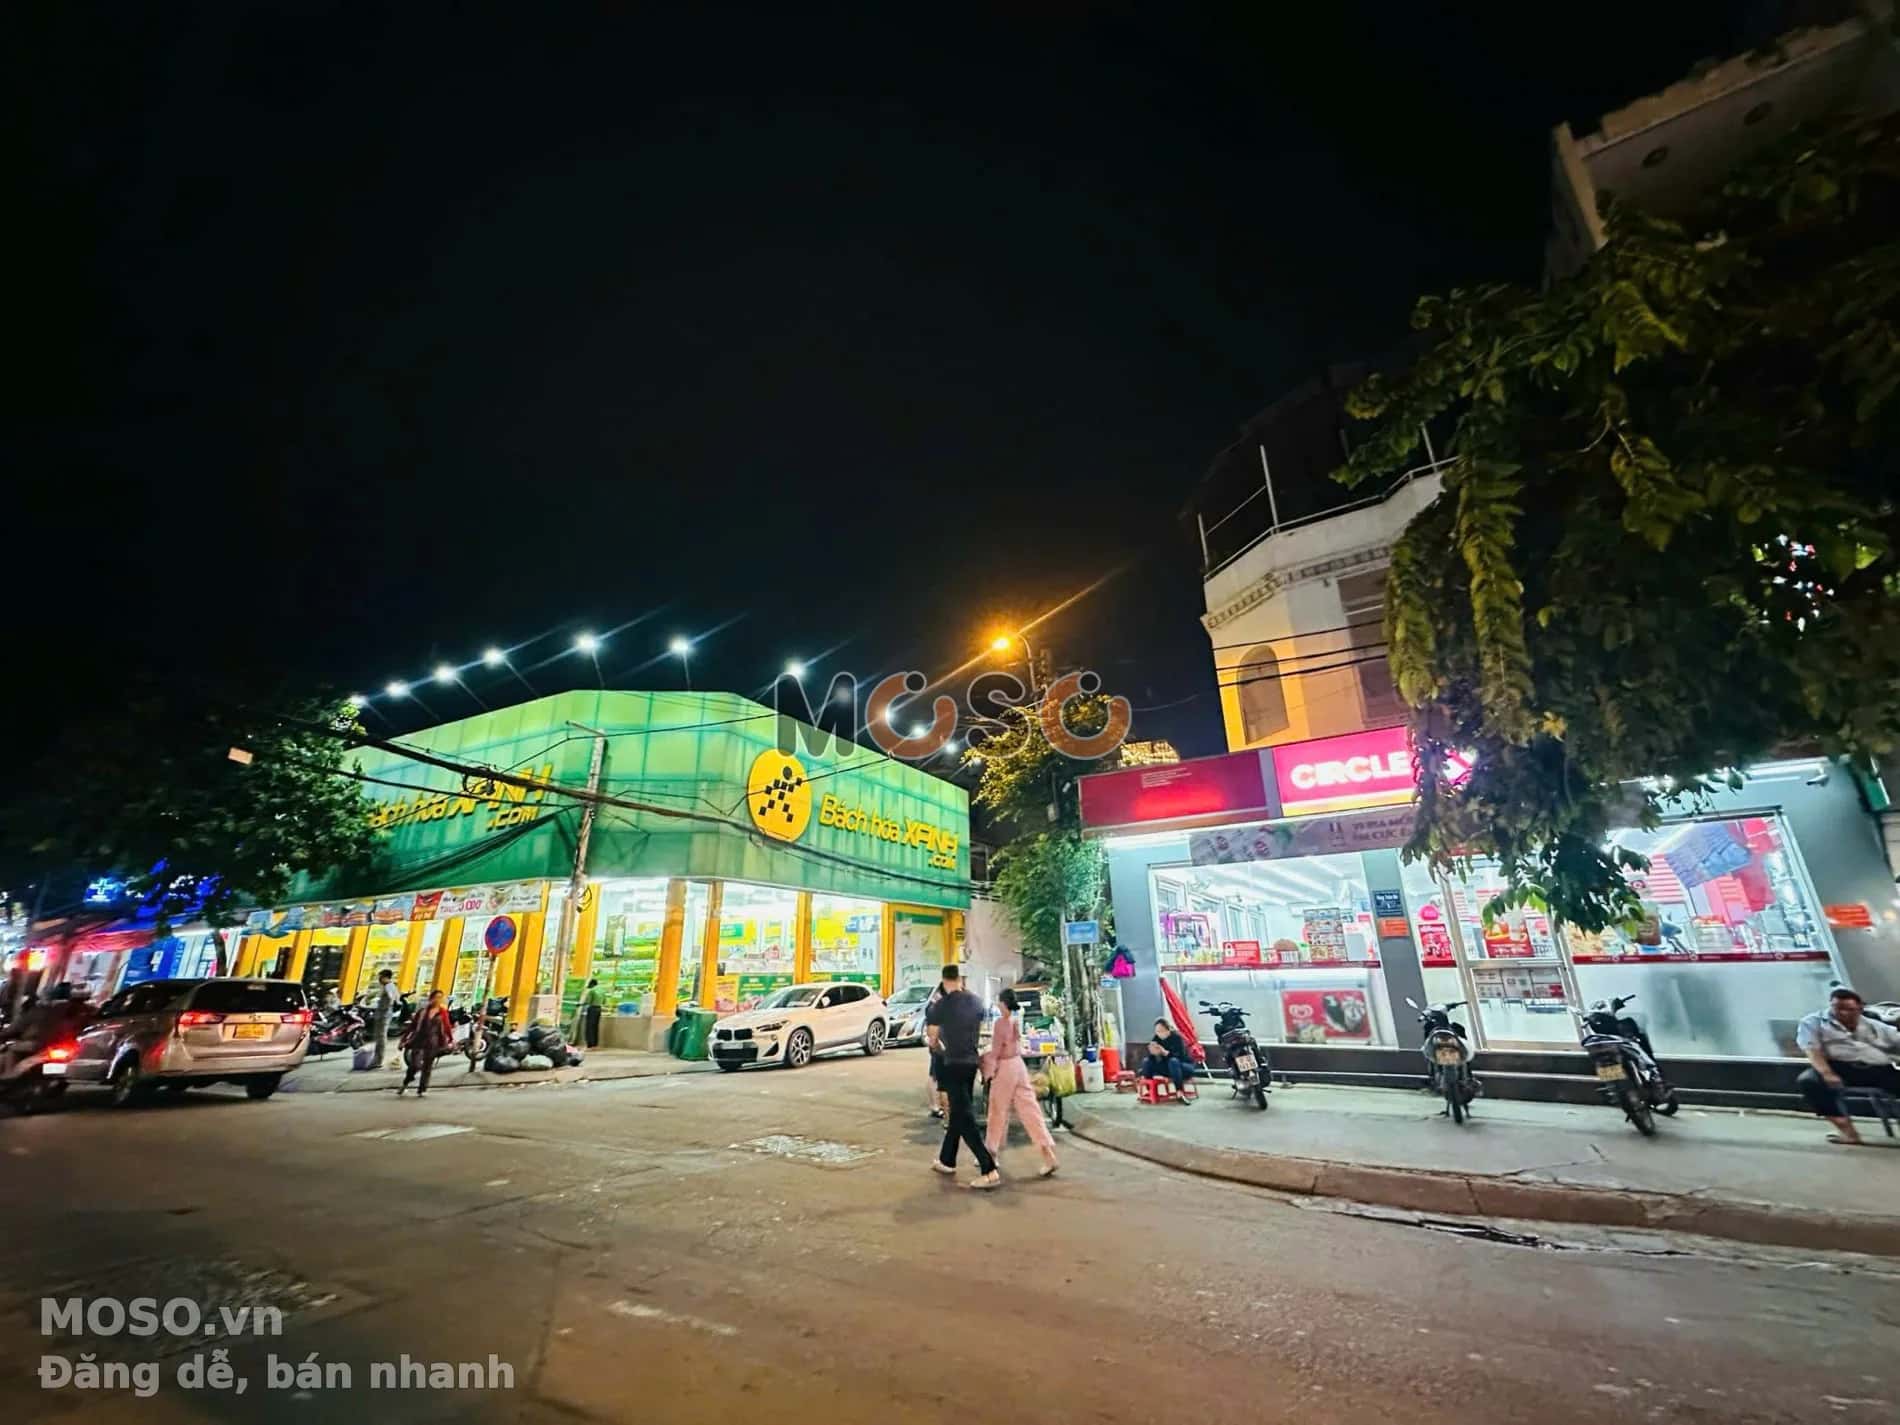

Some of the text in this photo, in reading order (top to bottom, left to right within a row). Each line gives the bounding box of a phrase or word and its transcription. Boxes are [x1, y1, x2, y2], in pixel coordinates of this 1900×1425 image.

[1290, 751, 1411, 789] CIRCLE
[819, 793, 959, 858] Bách hóa XANH
